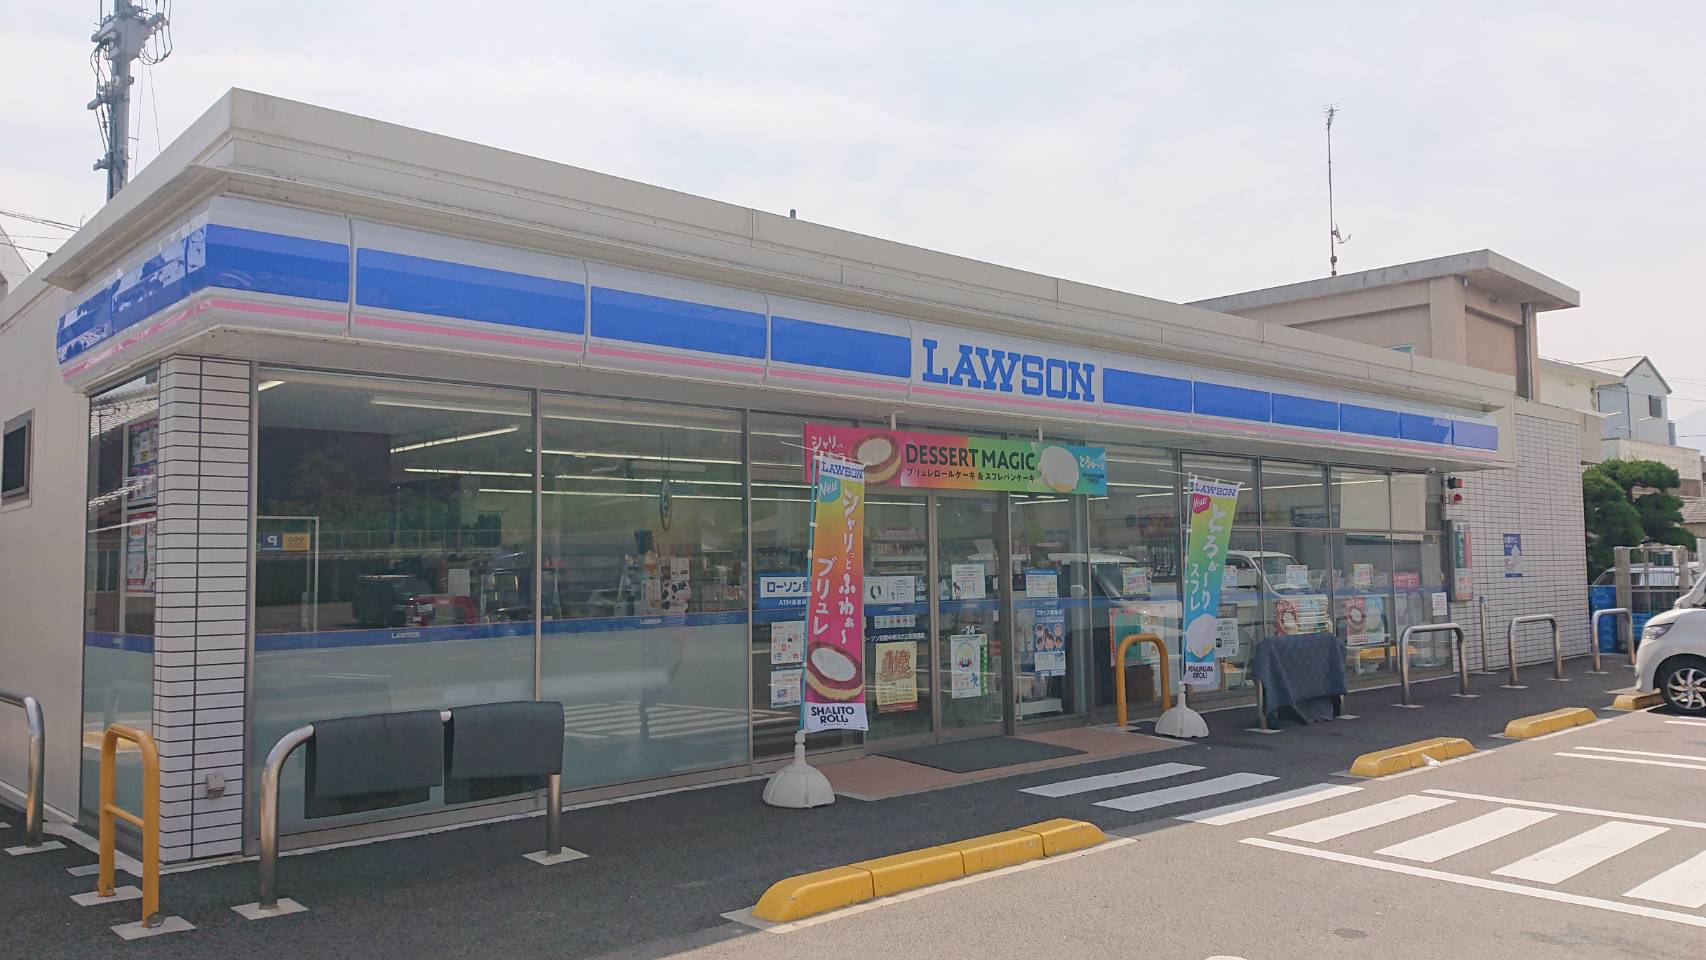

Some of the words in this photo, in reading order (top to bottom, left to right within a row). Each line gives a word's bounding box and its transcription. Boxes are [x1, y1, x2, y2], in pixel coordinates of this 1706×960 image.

[922, 338, 1095, 403] LAWSON
[905, 443, 979, 467] DESSERT
[981, 449, 1036, 471] MAGIC
[821, 461, 864, 480] LAWSON
[1194, 482, 1237, 497] LAWSON
[813, 555, 838, 636] ブリュレ
[1190, 563, 1201, 611] スフレ
[811, 706, 855, 717] SHALITO
[820, 714, 849, 725] ROLL
